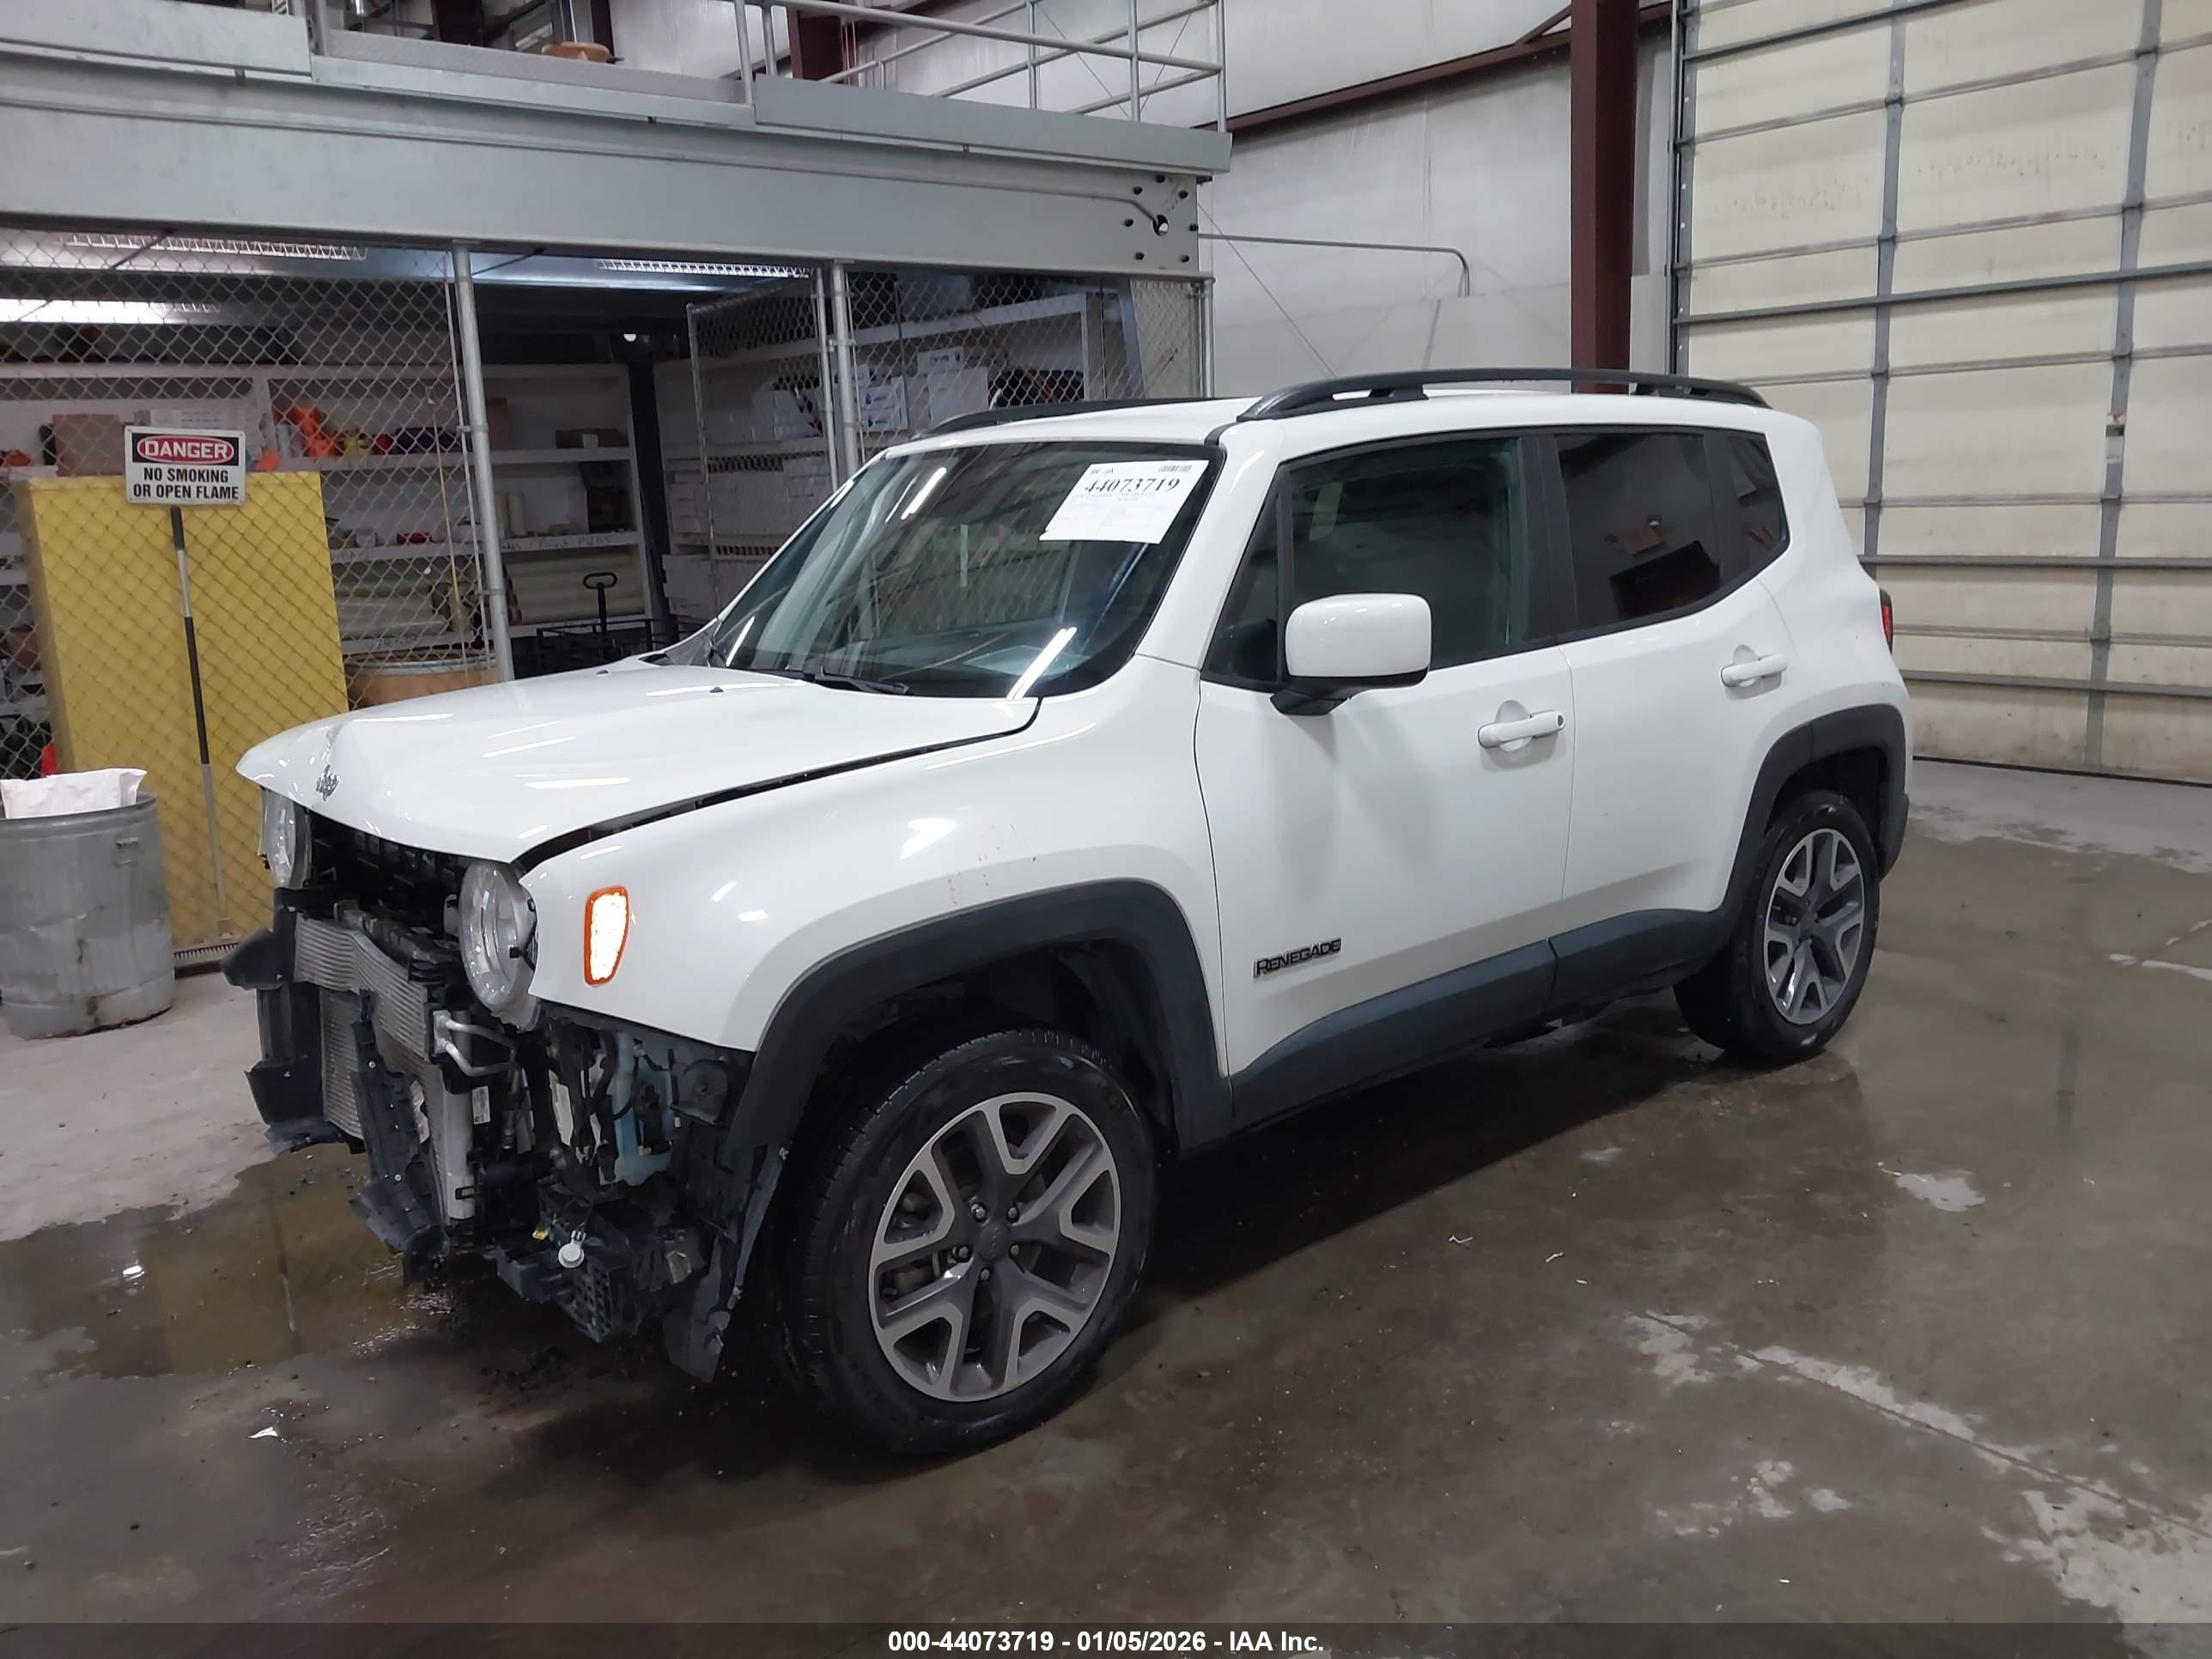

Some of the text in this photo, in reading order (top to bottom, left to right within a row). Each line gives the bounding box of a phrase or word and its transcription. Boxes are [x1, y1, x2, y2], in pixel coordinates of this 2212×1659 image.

[144, 440, 228, 459] DANGER
[143, 467, 229, 483] NO SMOKING
[133, 483, 240, 500] OR OPEN FLAME
[1085, 477, 1181, 493] 44073719
[1253, 938, 1342, 979] RENEGADE
